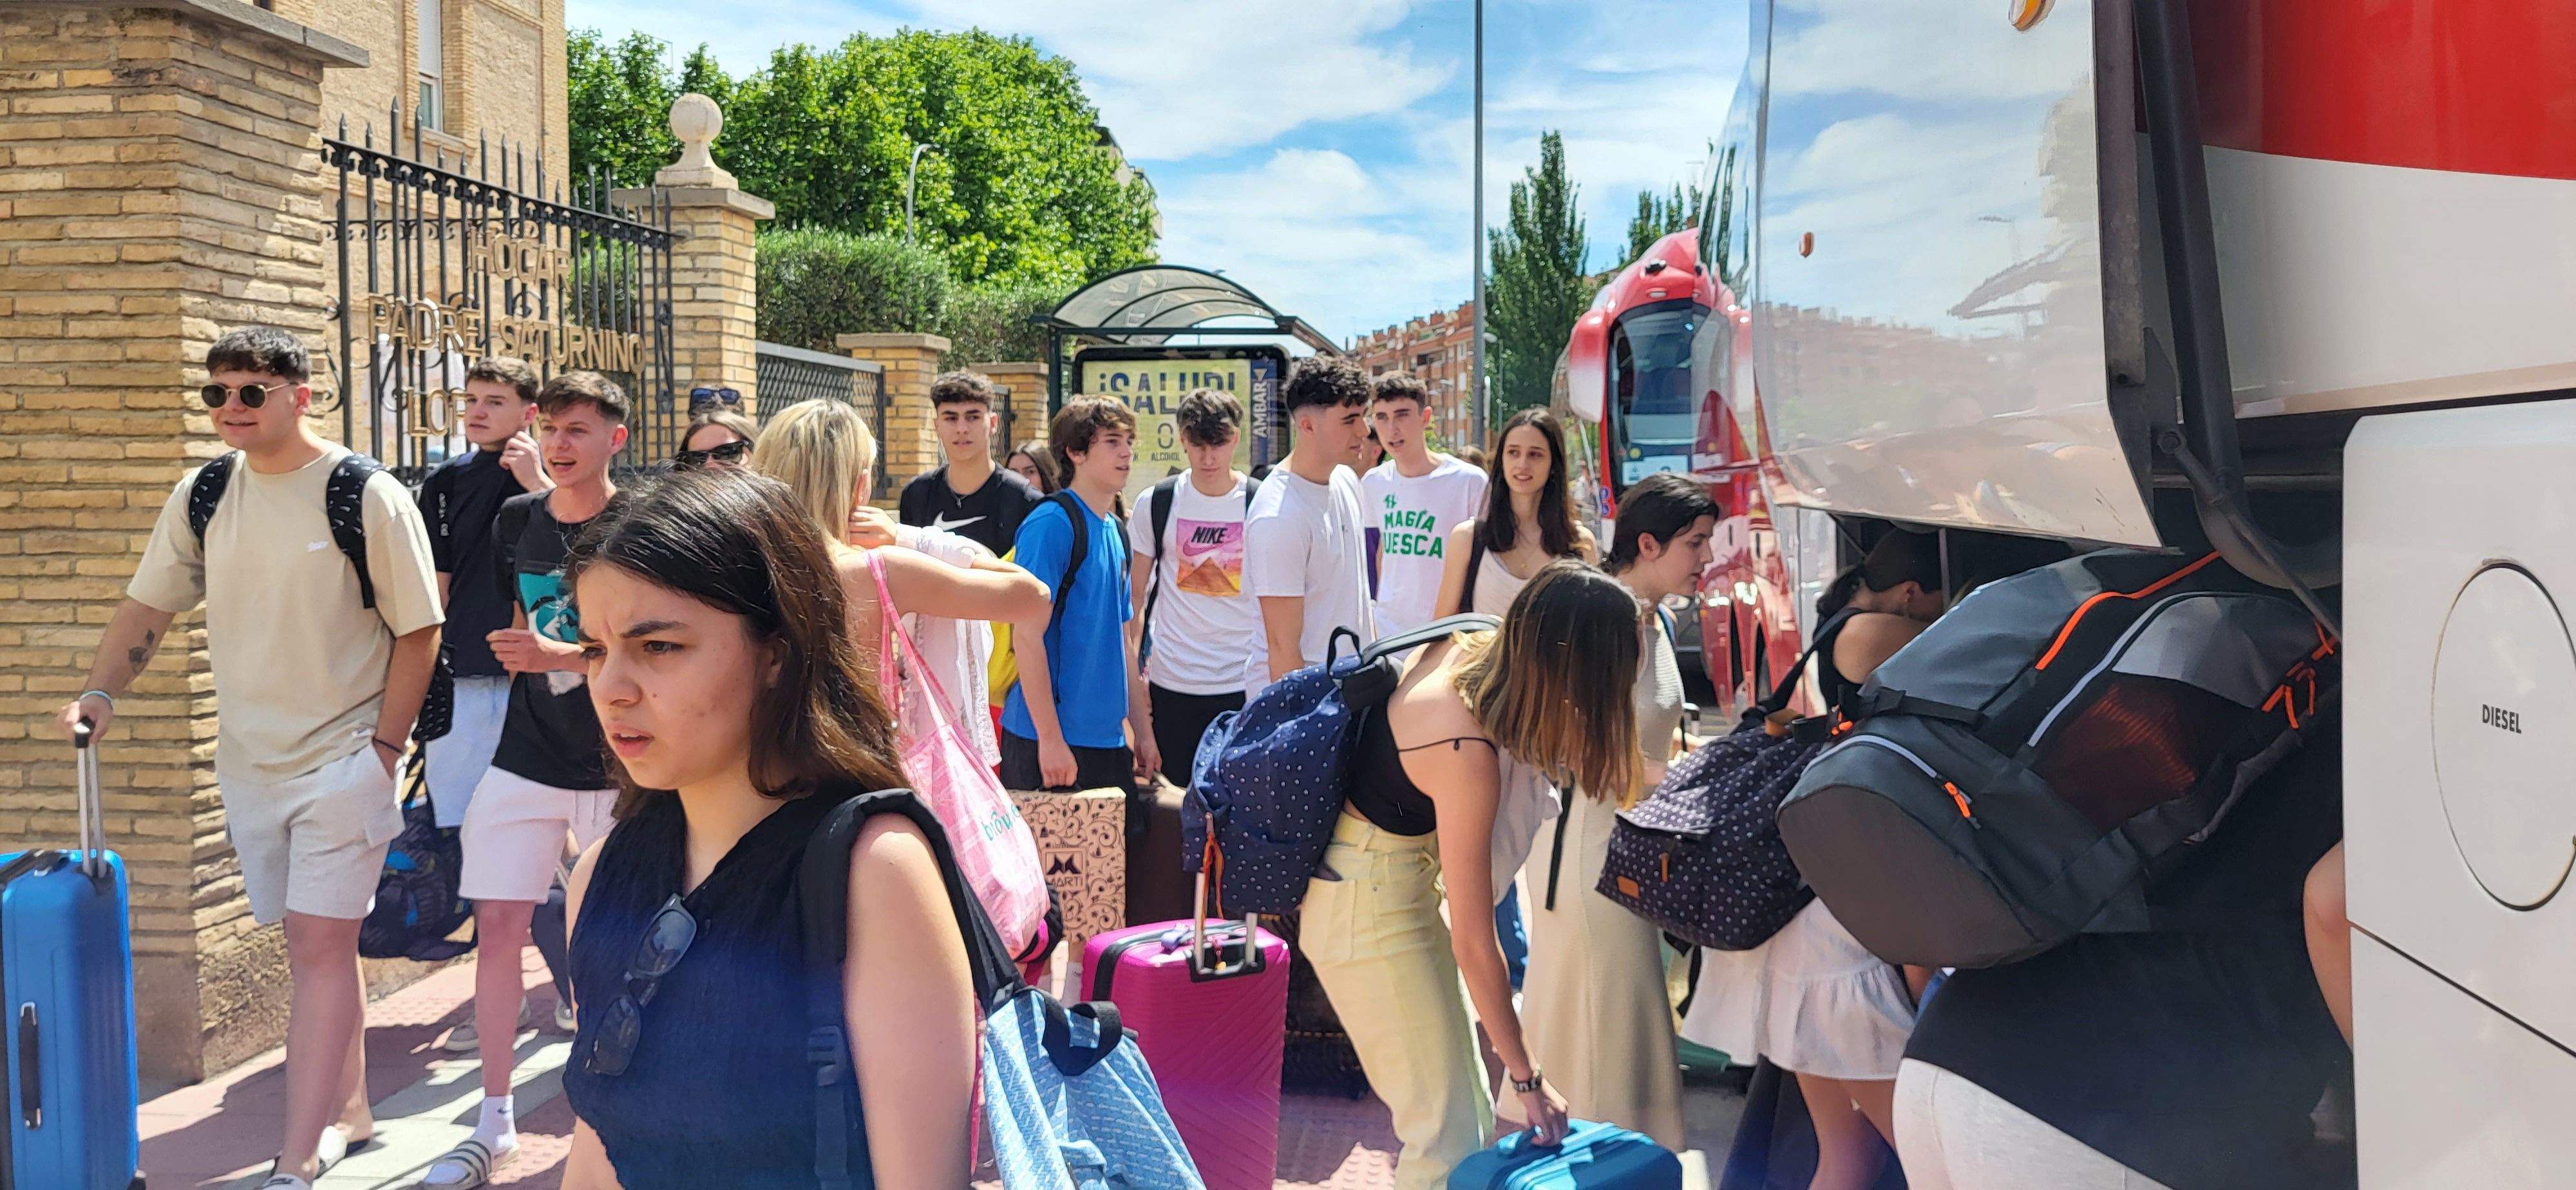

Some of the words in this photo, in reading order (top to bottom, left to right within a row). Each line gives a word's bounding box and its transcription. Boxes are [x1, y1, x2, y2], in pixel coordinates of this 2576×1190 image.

[469, 227, 570, 292] HOGAR
[368, 293, 483, 357] PADRE
[498, 316, 645, 373] SATURNINO
[1252, 381, 1267, 438] AMBAR
[1151, 452, 1180, 462] ALCOHOL
[1191, 525, 1228, 544] NIKE
[1384, 532, 1443, 559] UESCA
[2482, 704, 2522, 734] DIESEL
